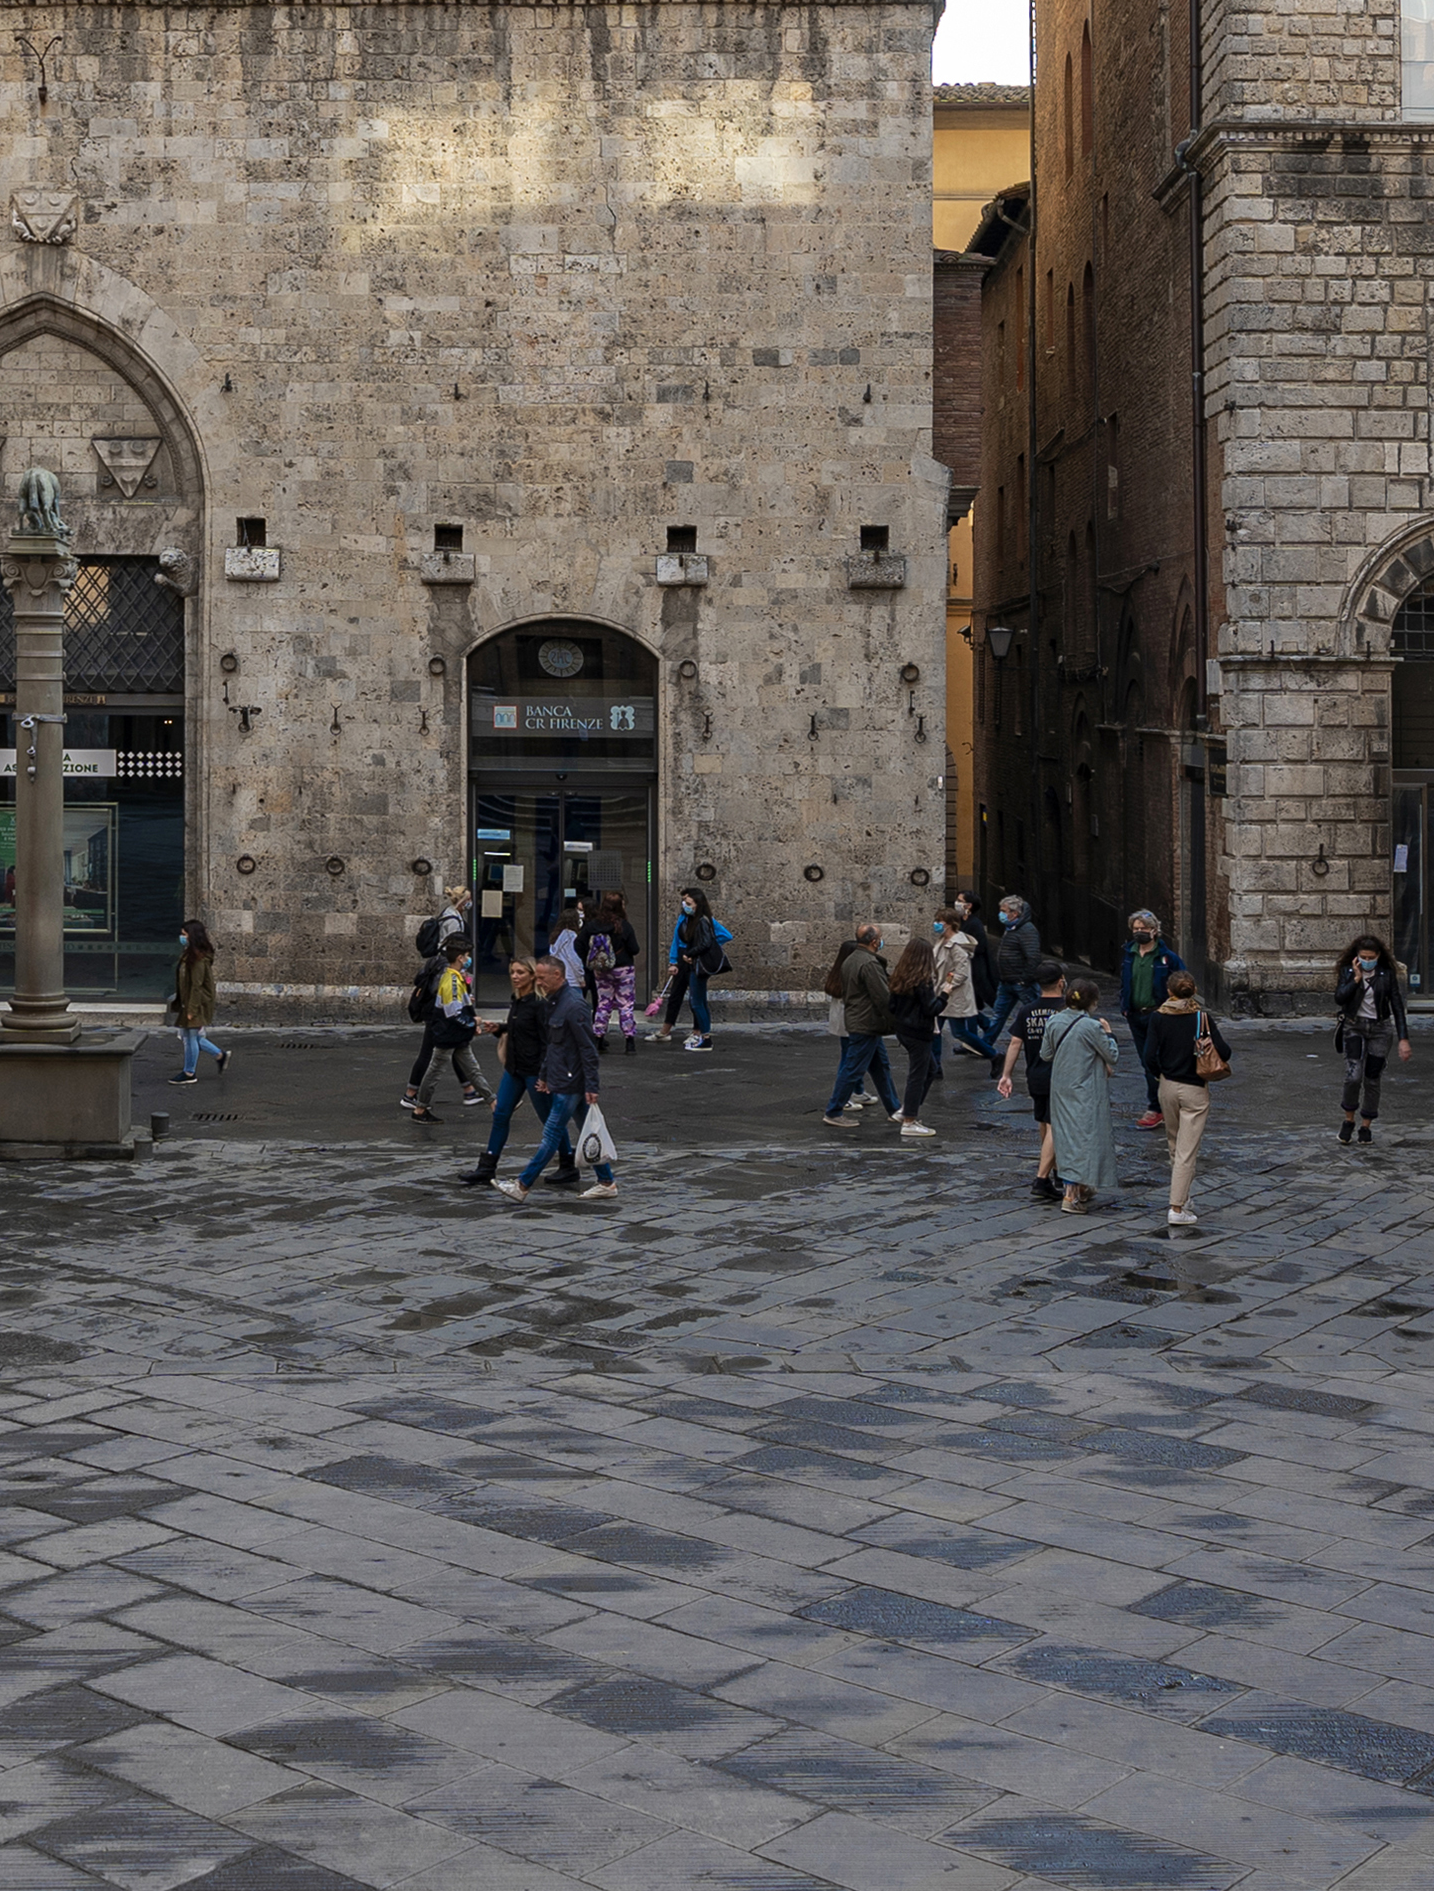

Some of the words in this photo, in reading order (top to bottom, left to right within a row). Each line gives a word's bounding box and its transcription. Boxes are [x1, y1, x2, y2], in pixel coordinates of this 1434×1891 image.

[526, 705, 572, 717] BANCA
[525, 718, 546, 729] CR
[549, 718, 604, 730] FIRENZE
